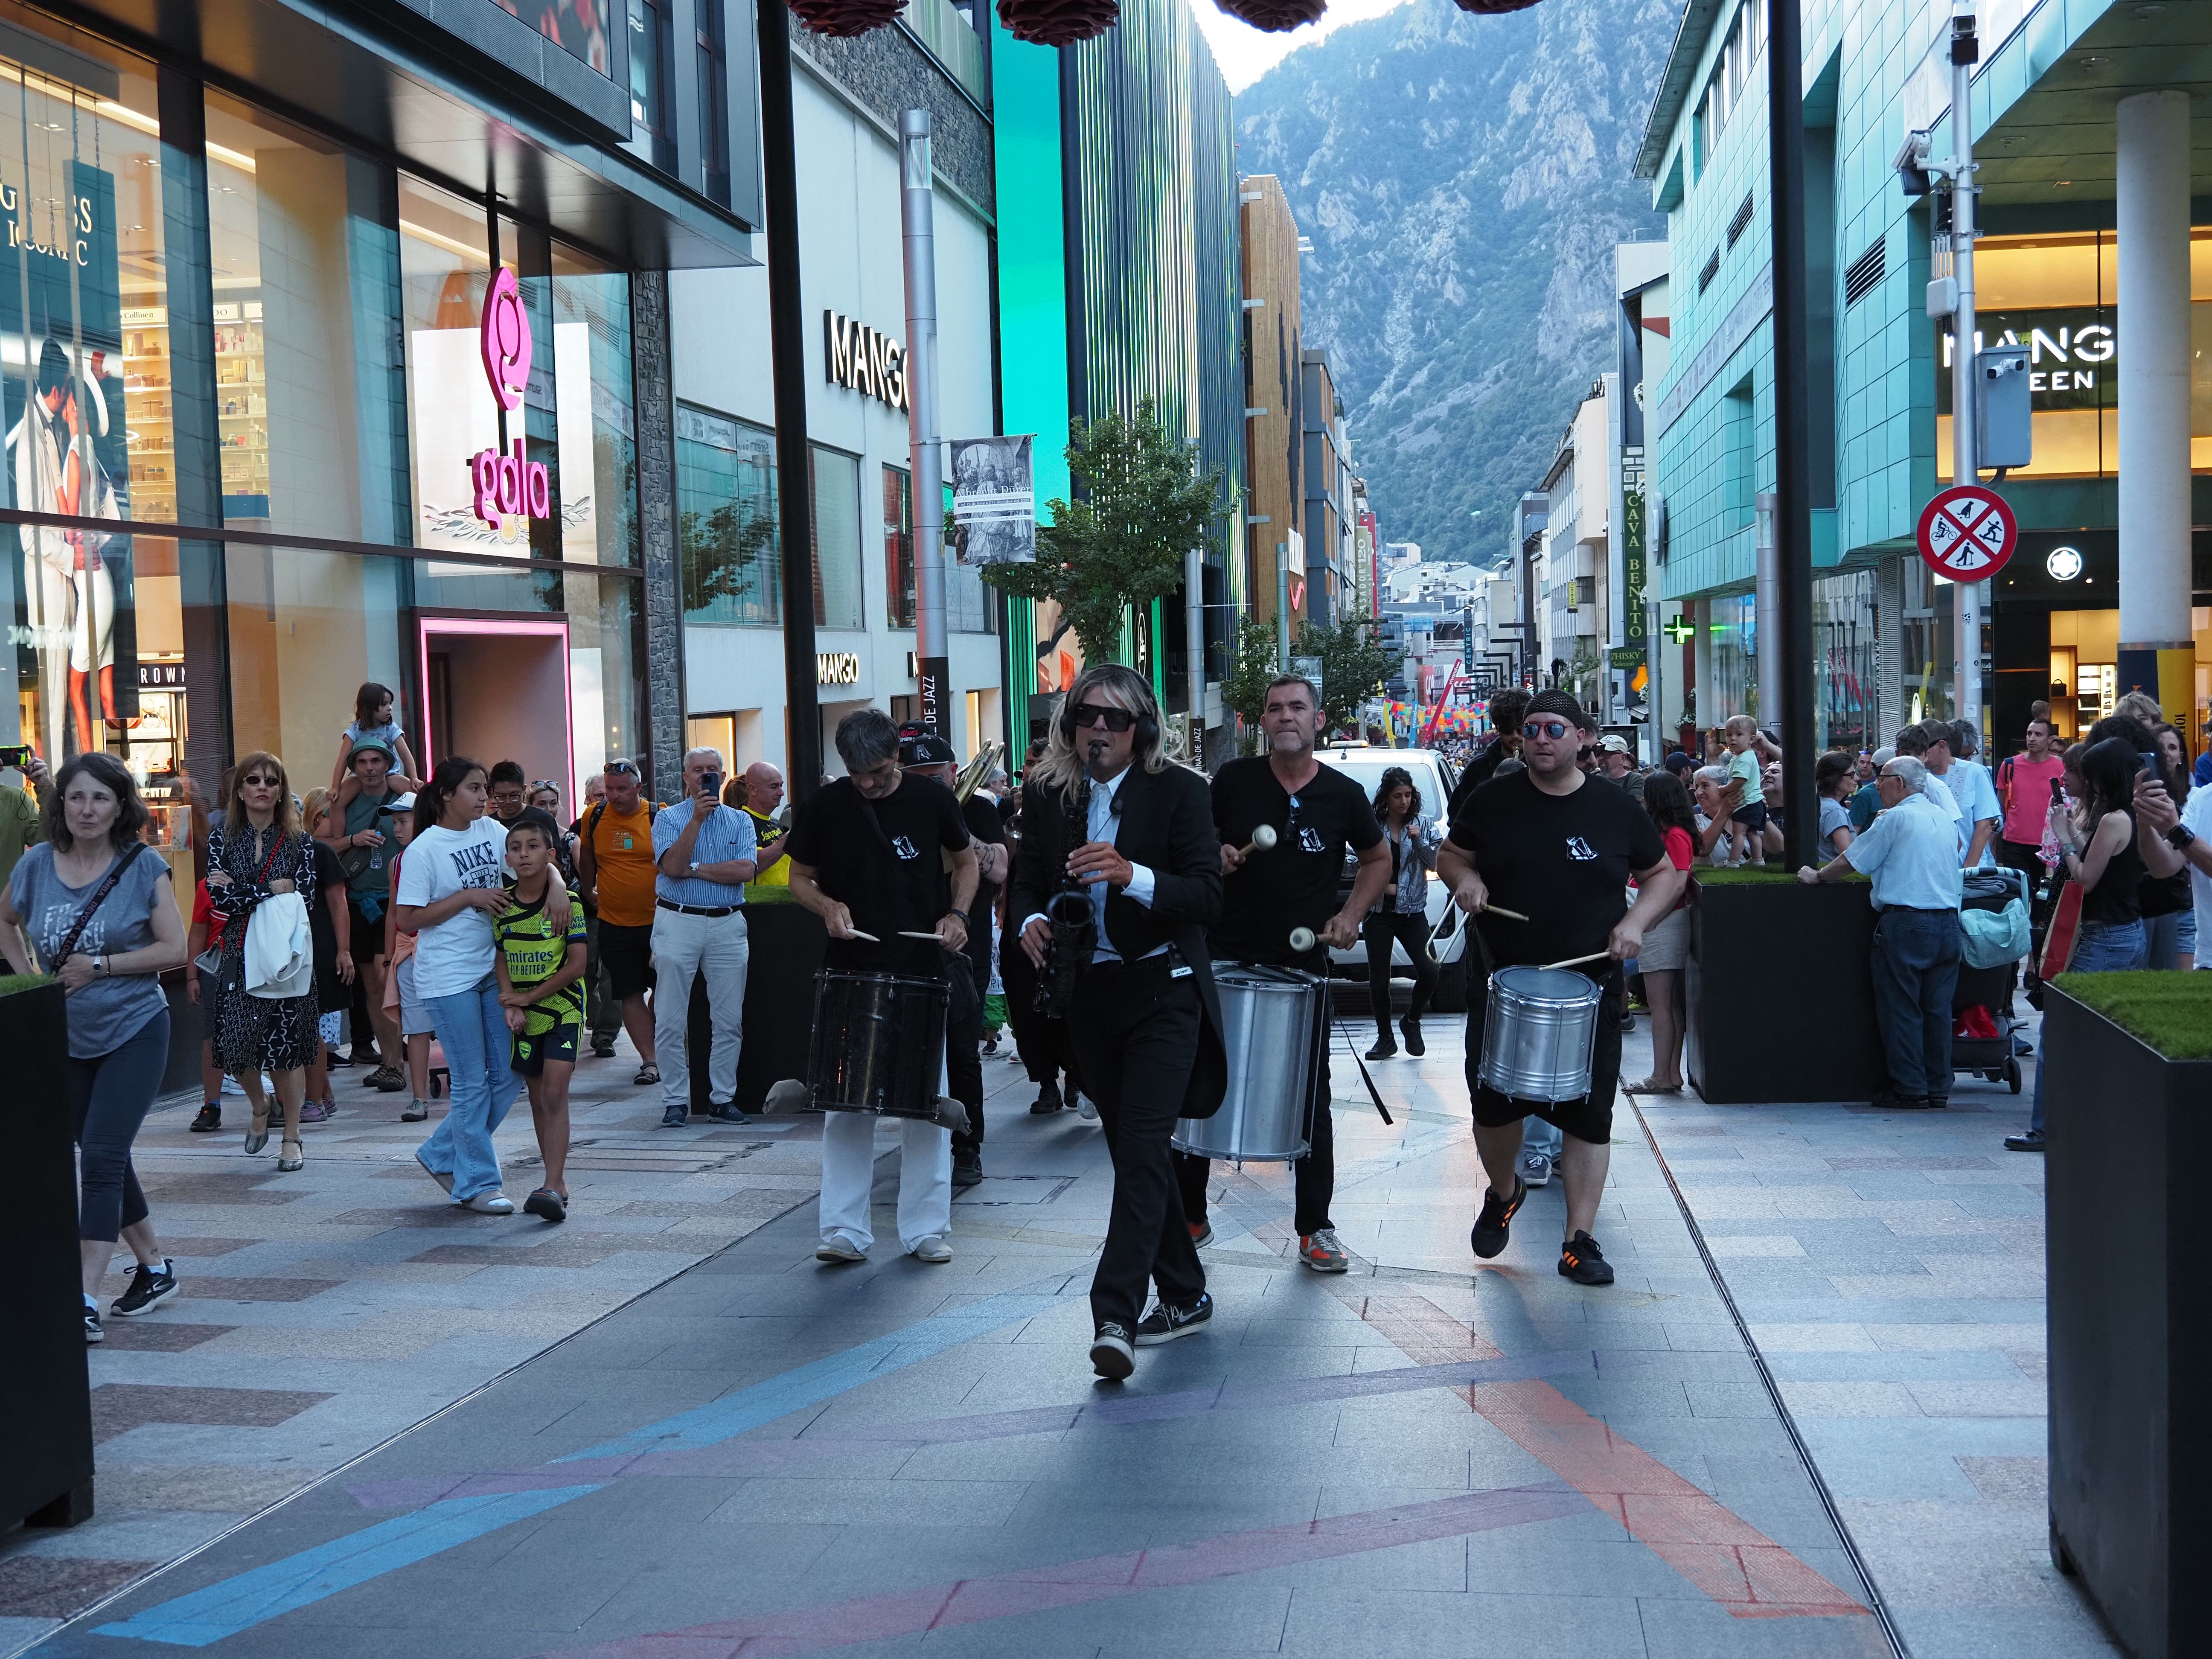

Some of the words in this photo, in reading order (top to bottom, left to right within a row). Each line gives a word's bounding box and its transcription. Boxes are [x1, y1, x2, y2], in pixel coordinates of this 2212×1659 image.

[824, 309, 909, 415] MANG
[472, 438, 550, 530] gala
[955, 486, 998, 497] Albrecht
[1001, 485, 1031, 494] Dürer
[1627, 495, 1640, 547] CAVA
[1628, 559, 1642, 637] BENITO
[817, 652, 859, 684] MANGO
[1449, 667, 1458, 685] vivand
[923, 675, 936, 705] JAZZ
[924, 708, 937, 724] DE
[900, 729, 919, 738] Blues
[1194, 744, 1202, 753] DE
[449, 841, 498, 879] NIKE
[55, 940, 73, 966] LOMBA
[504, 950, 553, 963] Emirates
[510, 965, 518, 975] FLY
[521, 964, 546, 975] BETTER
